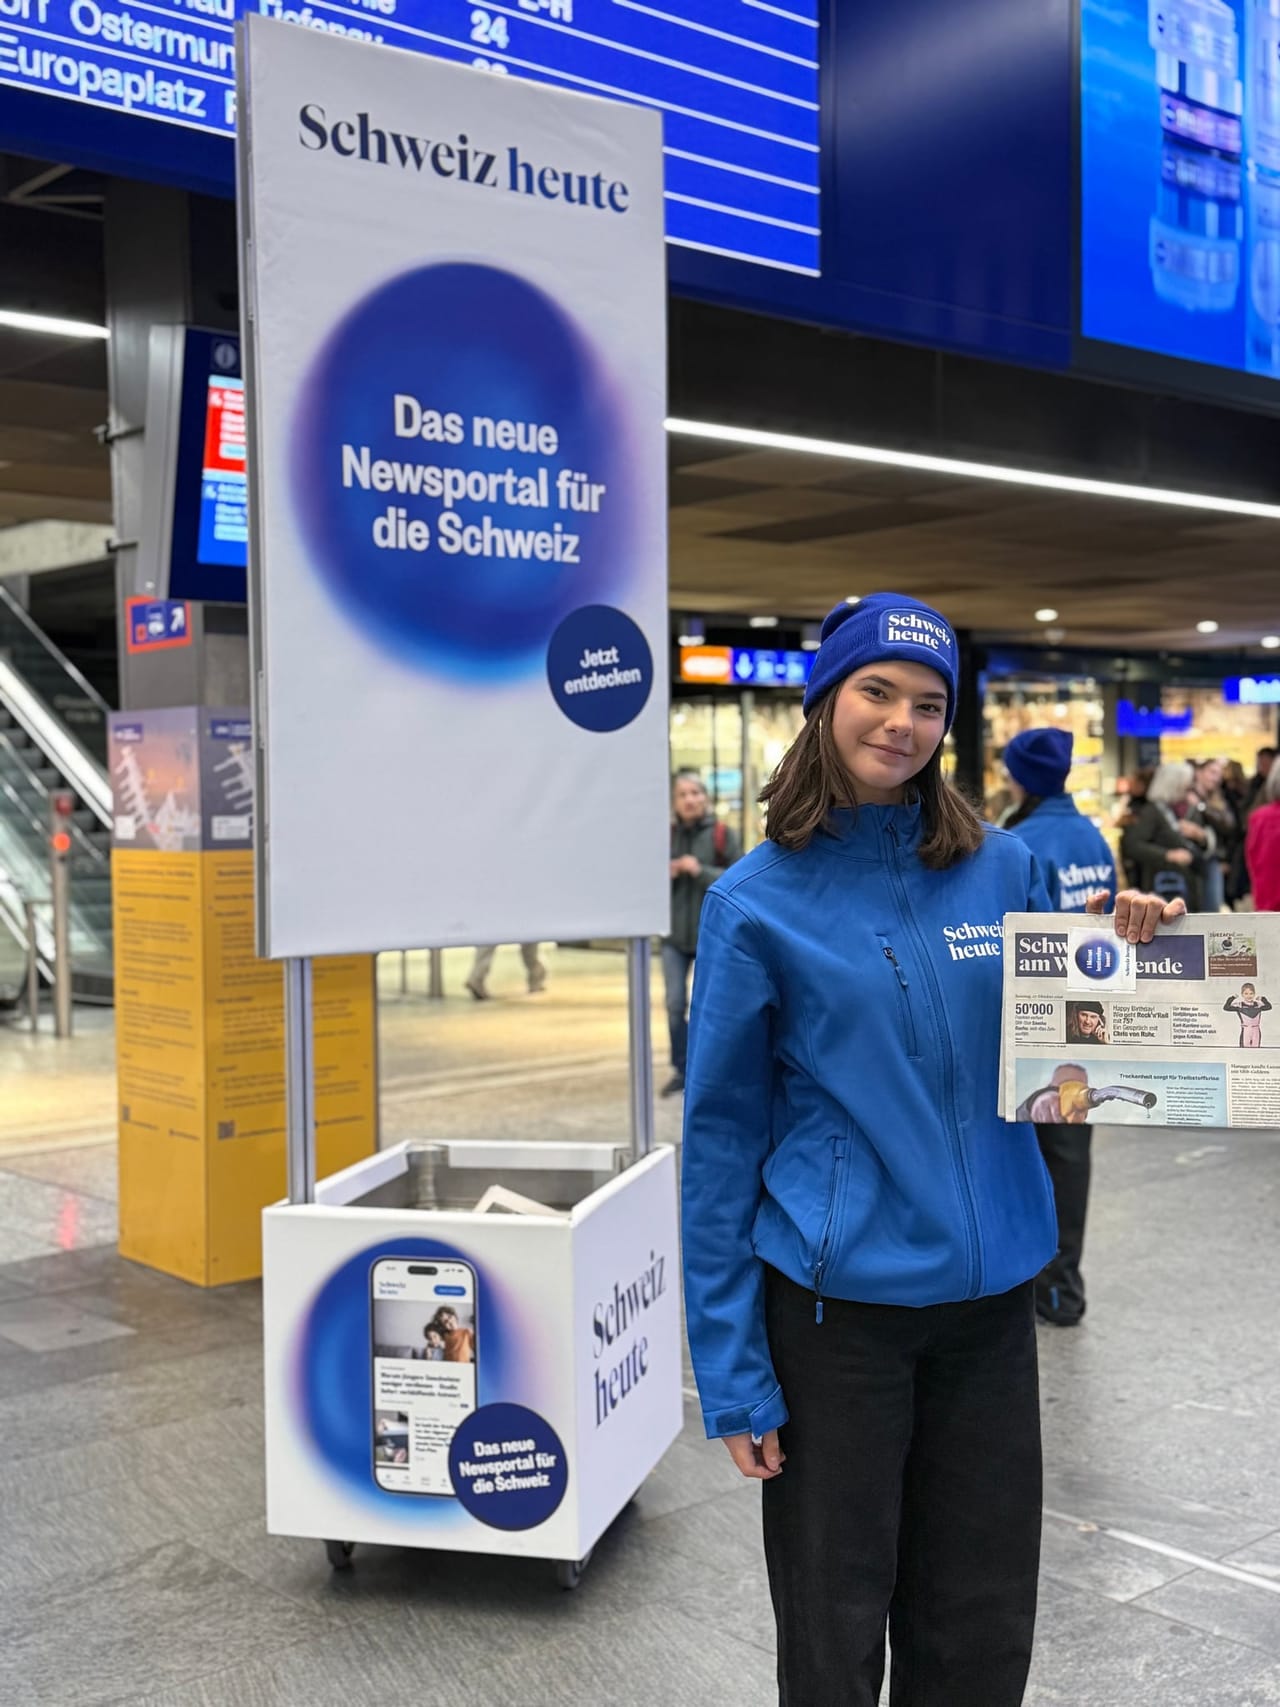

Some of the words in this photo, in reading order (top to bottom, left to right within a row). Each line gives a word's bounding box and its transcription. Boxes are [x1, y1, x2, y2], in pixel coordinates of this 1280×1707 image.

[470, 10, 510, 49] 24
[299, 103, 498, 188] Schweiz
[507, 147, 629, 213] heute
[394, 394, 464, 444] Das
[473, 416, 558, 455] neue
[342, 444, 548, 508] Newsportal
[557, 469, 606, 513] für
[372, 506, 430, 551] die
[438, 511, 580, 563] Schweiz
[888, 627, 940, 650] heute
[579, 646, 620, 669] Jetzt
[564, 667, 642, 695] entdecken
[948, 940, 1001, 961] heute
[1019, 958, 1050, 971] am
[1015, 1003, 1053, 1015] 50'000
[593, 1250, 666, 1359] Schweiz
[595, 1336, 649, 1429] heute
[473, 1441, 500, 1456] Das
[501, 1438, 535, 1454] neue
[459, 1453, 534, 1478] Newsportal
[535, 1452, 557, 1469] für
[472, 1477, 494, 1494] die
[495, 1472, 550, 1493] Schweiz
